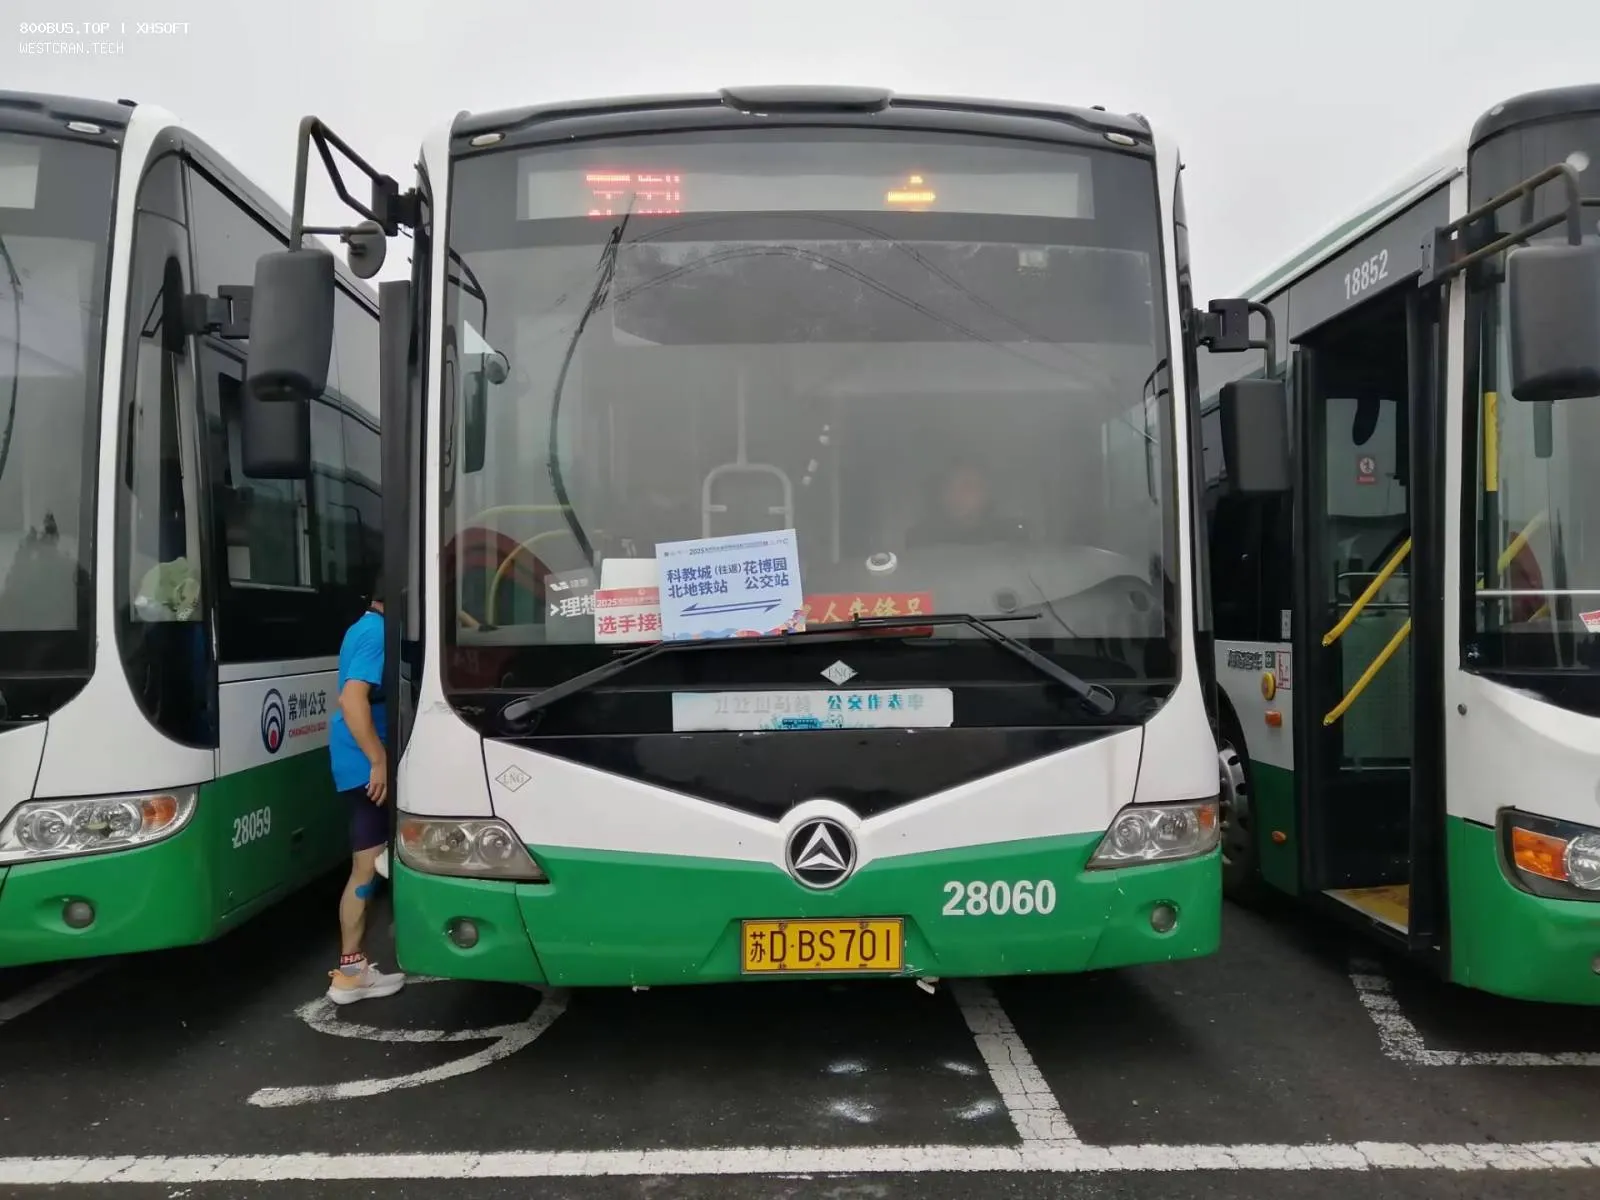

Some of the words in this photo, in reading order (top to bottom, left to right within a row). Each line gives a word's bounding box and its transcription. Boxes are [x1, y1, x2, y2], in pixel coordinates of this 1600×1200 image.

[1344, 249, 1389, 299] 18852
[667, 565, 713, 584] 科教城
[743, 557, 788, 576] 花博园
[668, 579, 728, 599] 北地铁站
[744, 572, 790, 590] 公交站
[598, 612, 663, 635] 选手接
[288, 689, 327, 721] 常州公交
[231, 806, 271, 849] 28059
[942, 879, 1057, 916] 28060
